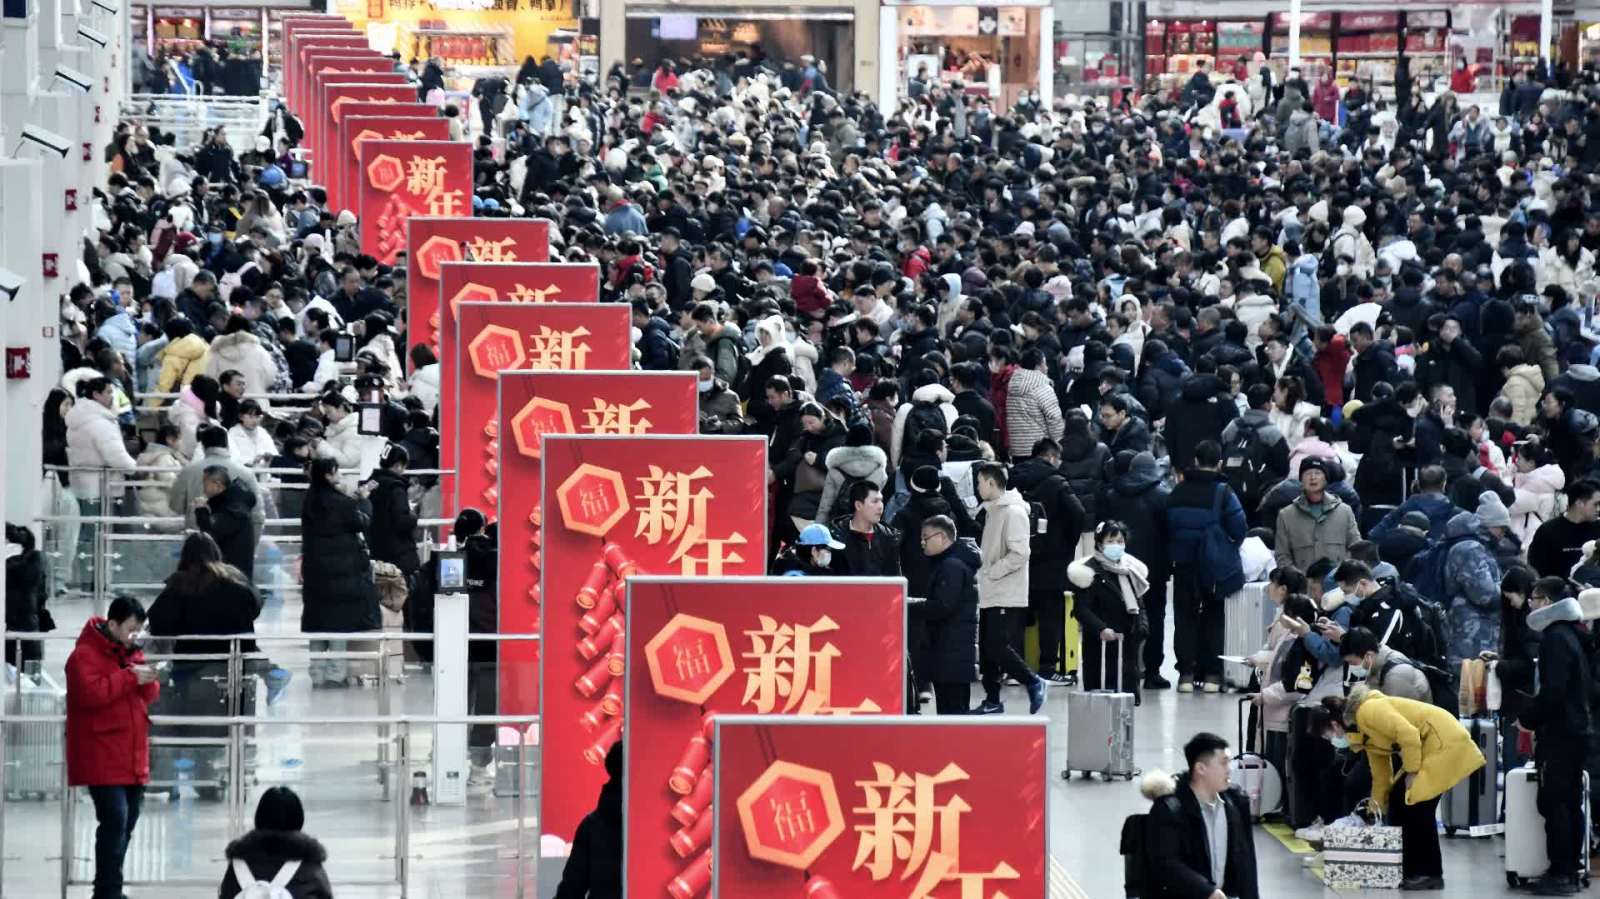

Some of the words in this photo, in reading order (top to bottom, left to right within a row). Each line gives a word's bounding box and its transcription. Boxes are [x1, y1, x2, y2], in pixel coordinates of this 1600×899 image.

[579, 483, 610, 518] 福
[672, 638, 711, 682] 福
[741, 614, 882, 715] 新
[769, 789, 816, 842] 福
